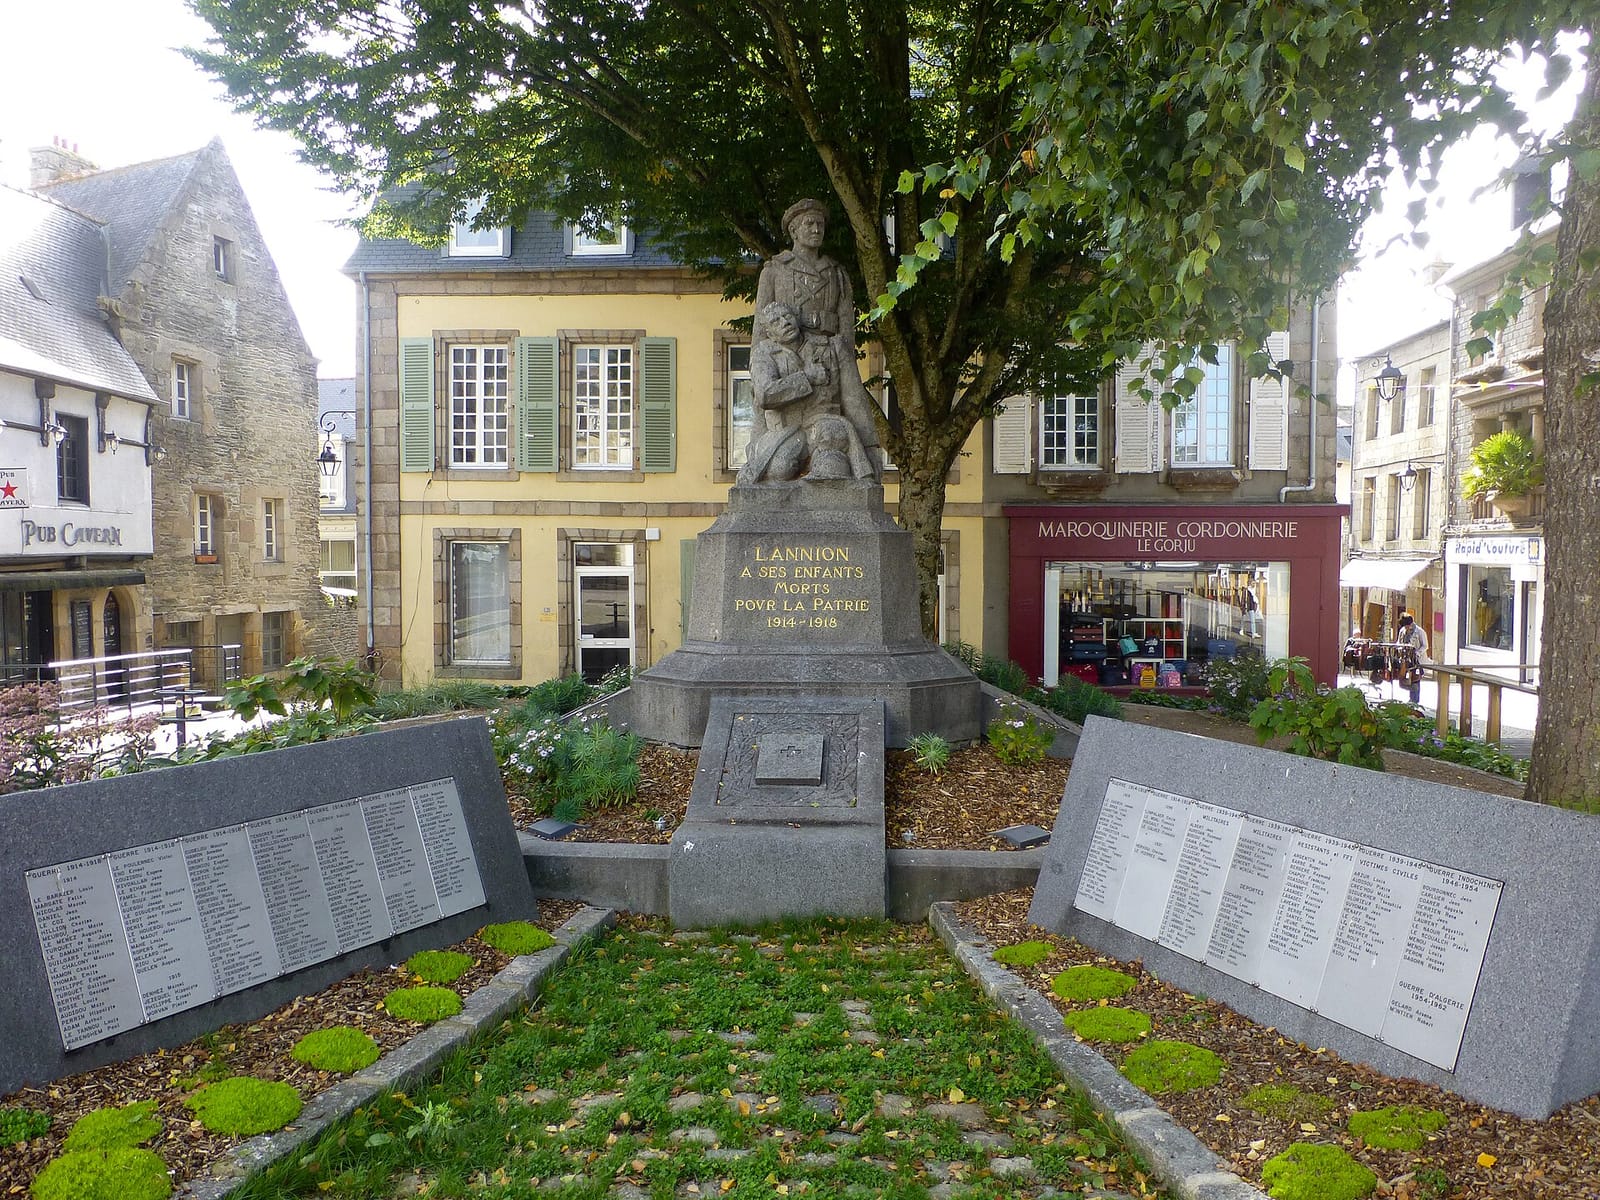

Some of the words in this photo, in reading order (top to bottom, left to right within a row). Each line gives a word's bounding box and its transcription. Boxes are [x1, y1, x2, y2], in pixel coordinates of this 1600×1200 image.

[22, 520, 57, 546] PUB
[61, 522, 123, 547] CAVERN
[1038, 521, 1168, 540] MAROQUINERIE
[1176, 521, 1298, 538] CORDONNERIE
[1137, 539, 1151, 552] LE
[1153, 539, 1196, 553] GORJU
[754, 547, 849, 562] LANNION
[740, 566, 752, 578] A
[758, 566, 787, 578] SES
[794, 566, 864, 578] ENFANTS
[774, 582, 830, 594] MORTS
[783, 600, 805, 611] LA
[812, 597, 870, 611] PATRIE
[66, 857, 102, 871] 1914-1918
[1358, 858, 1389, 872] VICTIMES
[1391, 868, 1419, 880] CIVILES
[1428, 866, 1455, 878] GUERRE
[1457, 874, 1496, 890] INDOCHINE
[1441, 877, 1479, 893] 1946-1954
[1398, 979, 1424, 995] GUERRE
[1428, 991, 1464, 1010] D'ALGERIE
[1410, 992, 1447, 1011] 1954-1962
